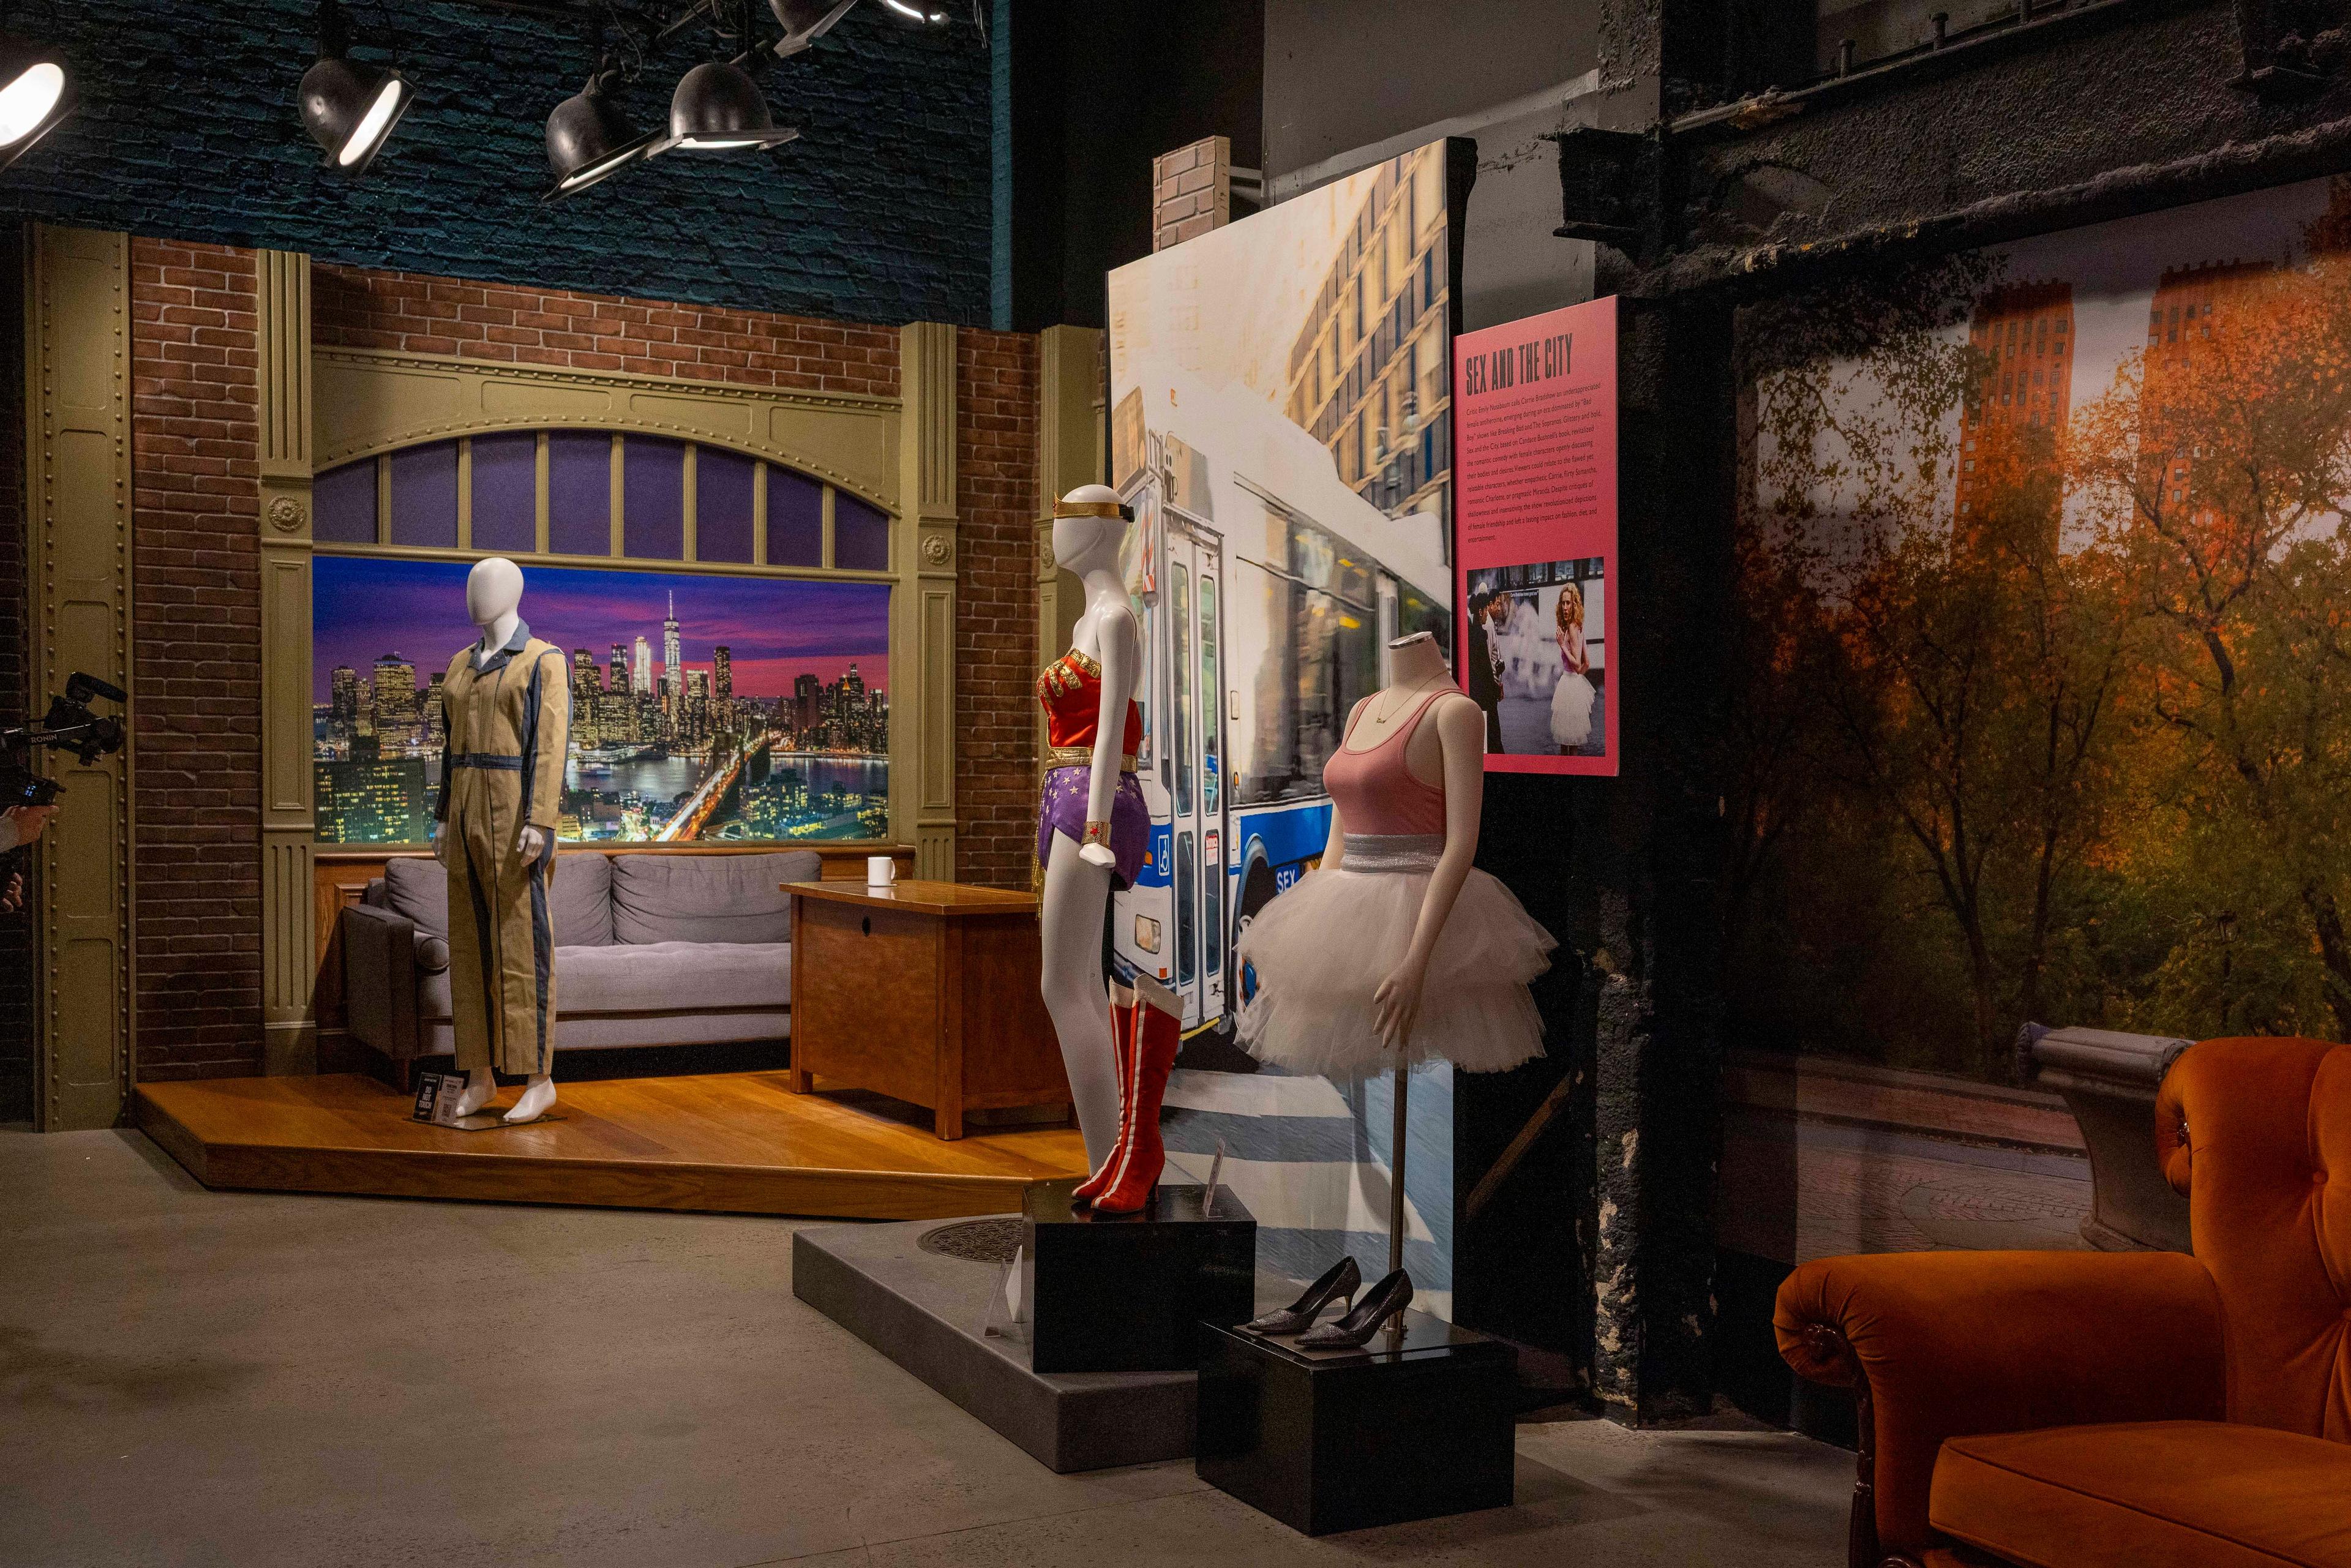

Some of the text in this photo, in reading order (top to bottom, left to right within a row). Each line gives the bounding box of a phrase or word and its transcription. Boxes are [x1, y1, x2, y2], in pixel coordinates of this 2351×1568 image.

[1466, 332, 1573, 396] SEX AND THE CITY
[31, 733, 58, 743] RONIN
[419, 1100, 432, 1109] TOUCH
